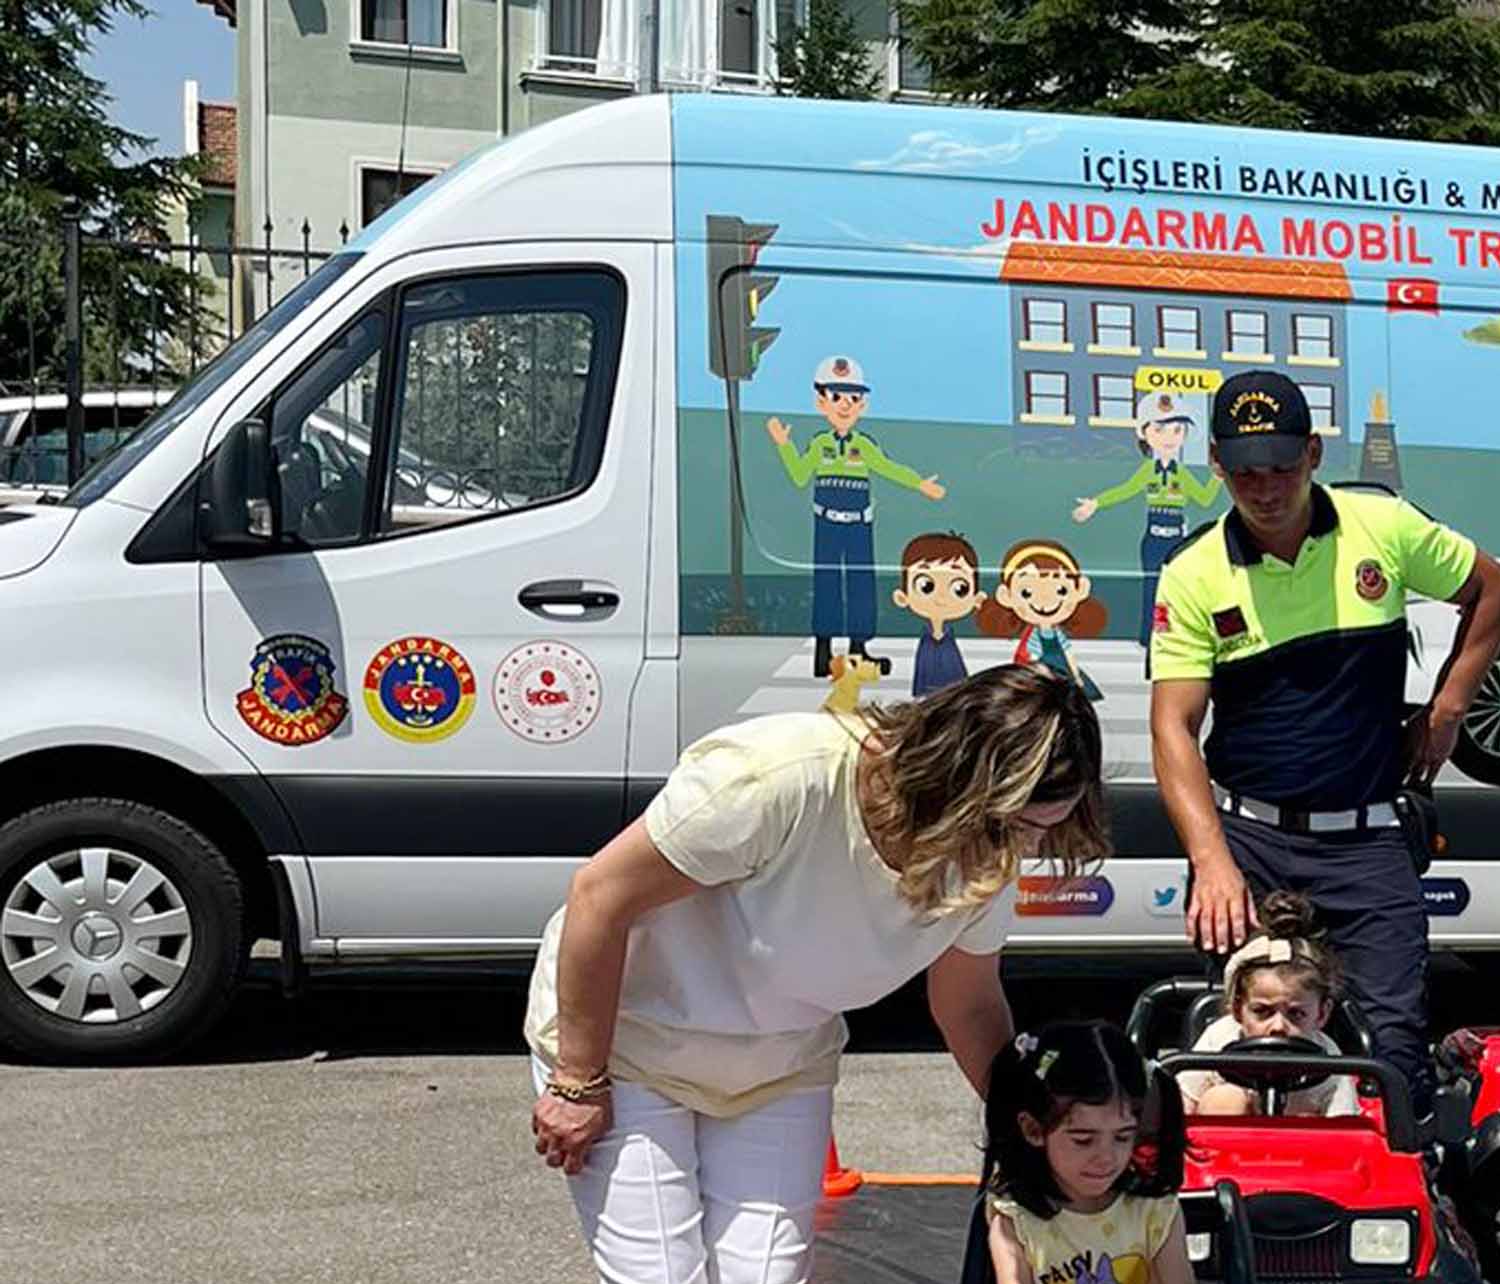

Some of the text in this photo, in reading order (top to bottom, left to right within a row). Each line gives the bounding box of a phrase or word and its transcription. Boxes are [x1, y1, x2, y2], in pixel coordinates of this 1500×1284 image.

[1082, 147, 1223, 194] İÇİŞLERİ
[1238, 165, 1429, 206] BAKANLIĞI
[1444, 181, 1466, 208] &
[980, 197, 1266, 254] JANDARMA
[1281, 213, 1434, 265] MOBİL
[1147, 371, 1212, 390] OKUL
[368, 637, 471, 684] JANDARMA
[241, 698, 345, 740] JANDARMA
